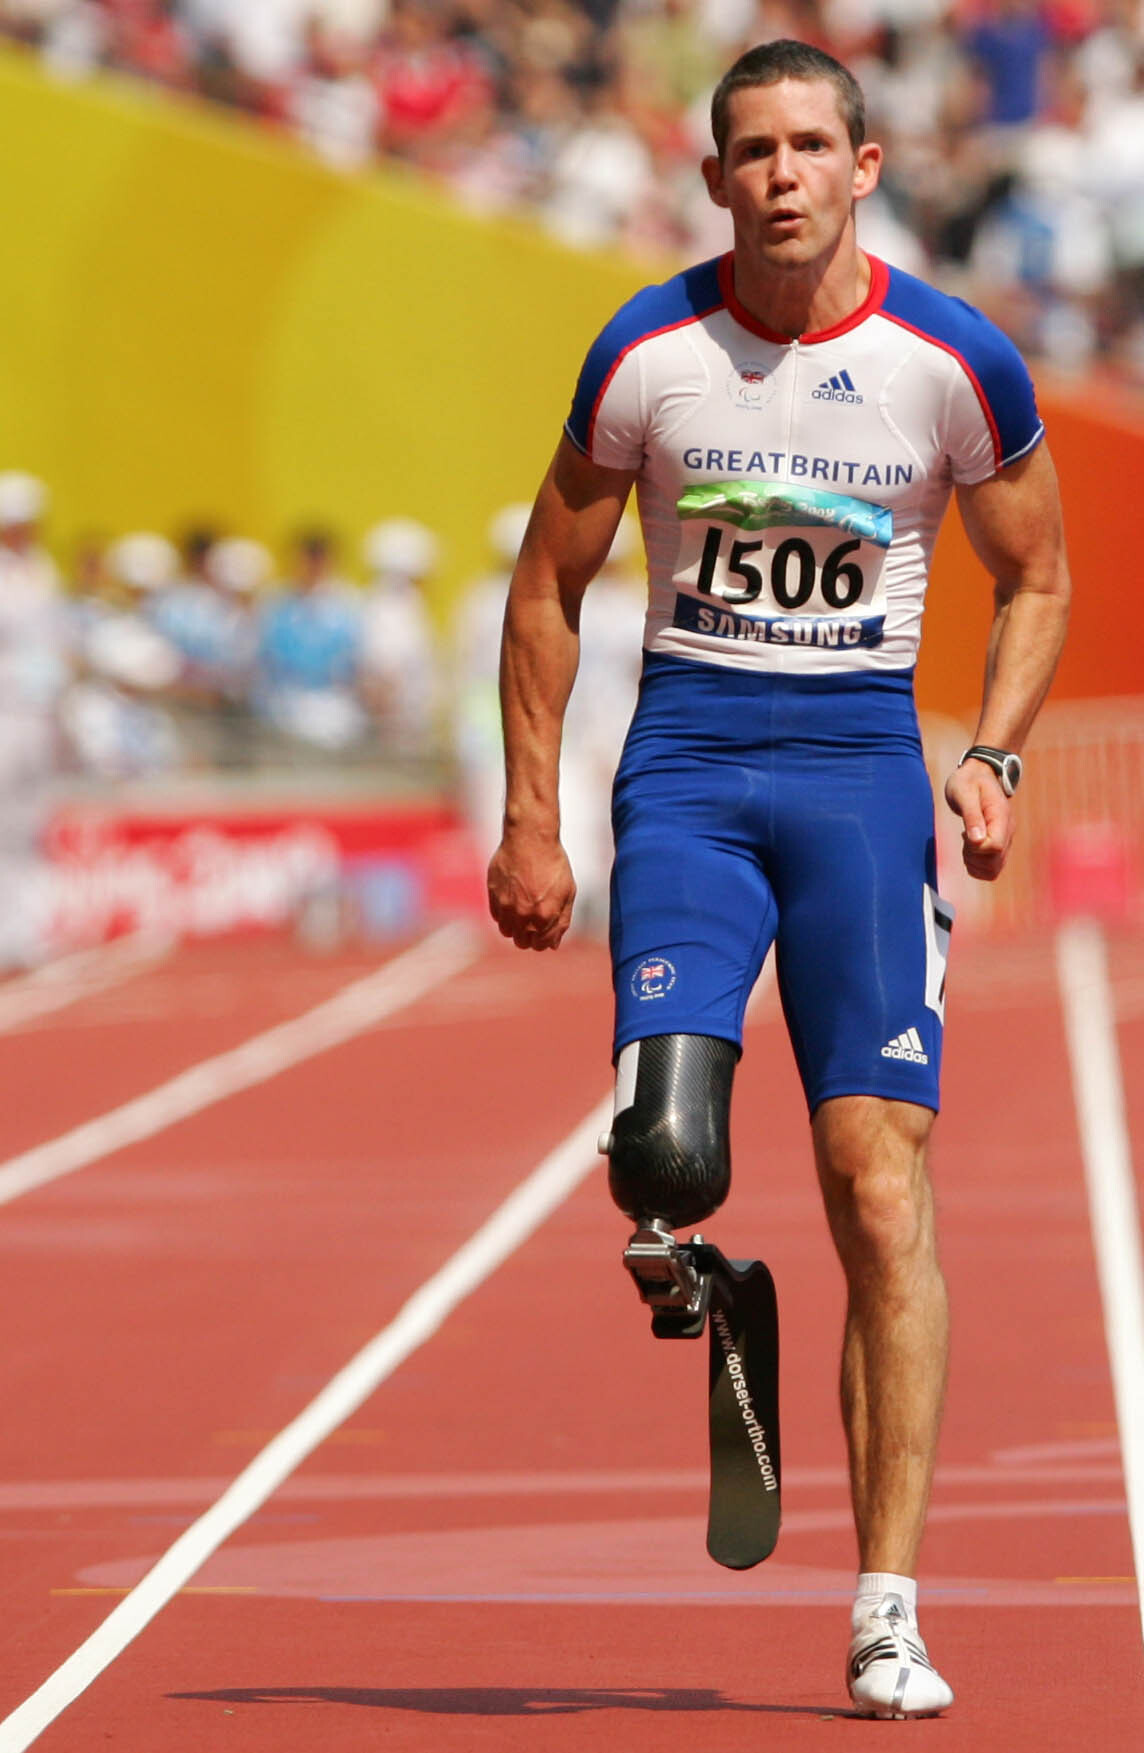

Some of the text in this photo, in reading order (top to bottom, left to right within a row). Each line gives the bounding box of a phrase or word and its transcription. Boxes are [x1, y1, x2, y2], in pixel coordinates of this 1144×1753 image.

[811, 387, 864, 405] adidas
[697, 526, 864, 610] 1506
[697, 608, 863, 647] SAMSUNG
[880, 1045, 929, 1065] adidas
[712, 1308, 779, 1492] www.dorset-ortho.com
